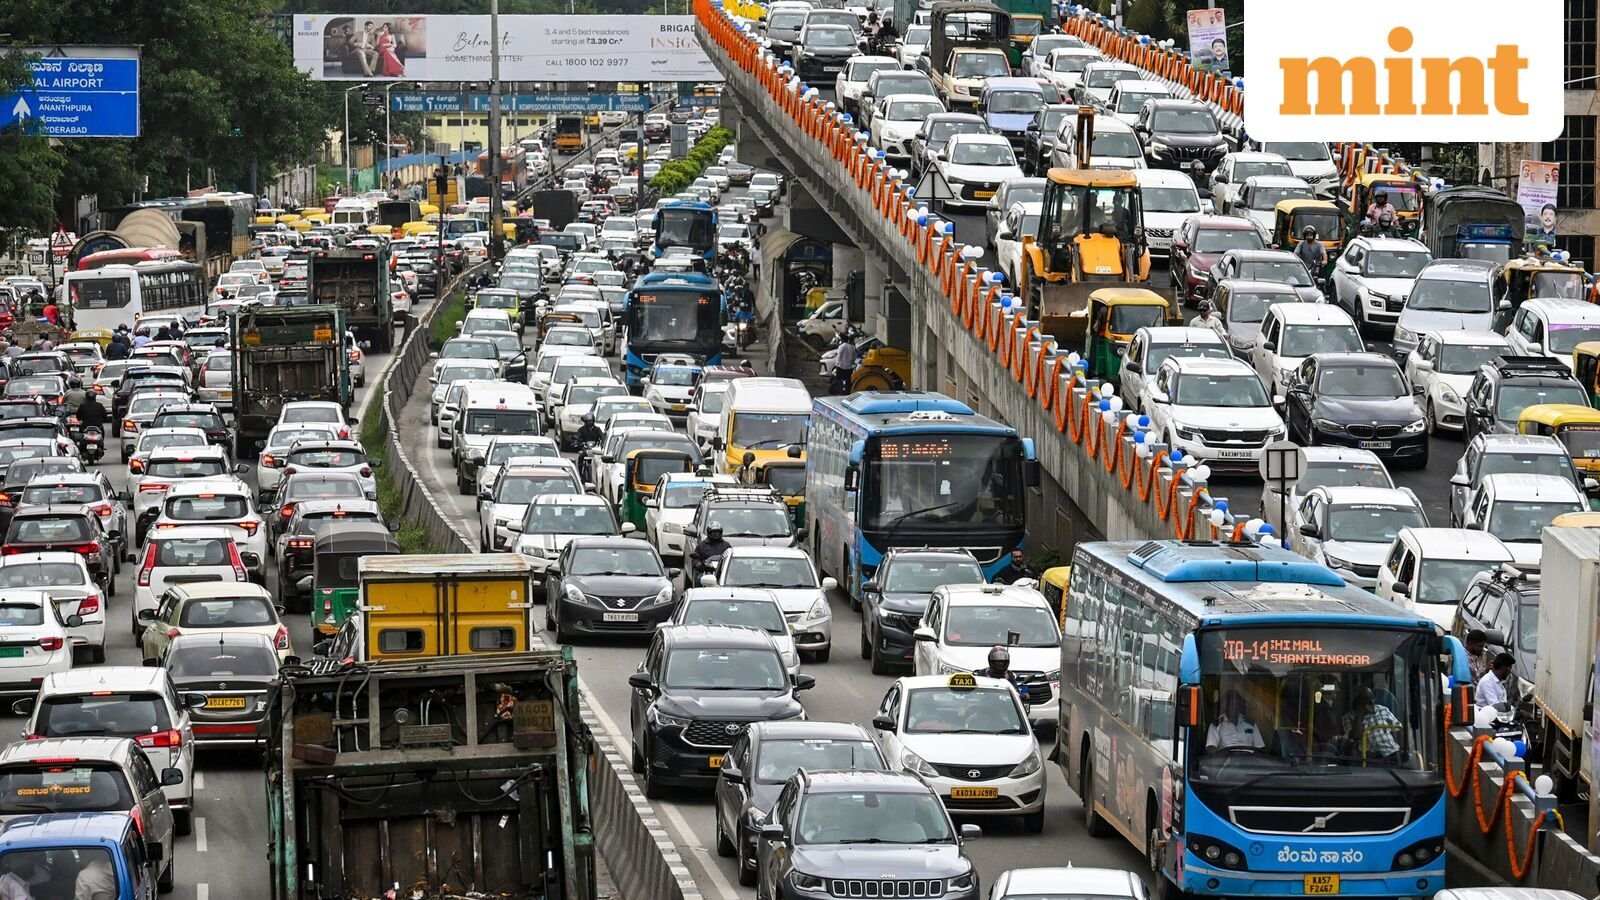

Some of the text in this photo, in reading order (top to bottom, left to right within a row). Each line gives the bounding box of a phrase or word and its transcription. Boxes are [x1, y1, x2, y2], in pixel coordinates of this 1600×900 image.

[551, 37, 577, 46] starting
[565, 58, 587, 66] 1800
[589, 58, 604, 66] 102
[606, 58, 629, 66] 9977
[52, 79, 104, 88] AIRPORT
[38, 104, 93, 112] ANANTHPURA
[1292, 640, 1322, 651] MALL
[1270, 654, 1370, 664] SHANTHINAGAR
[1312, 876, 1331, 884] KA57
[1310, 885, 1333, 893] F2467
